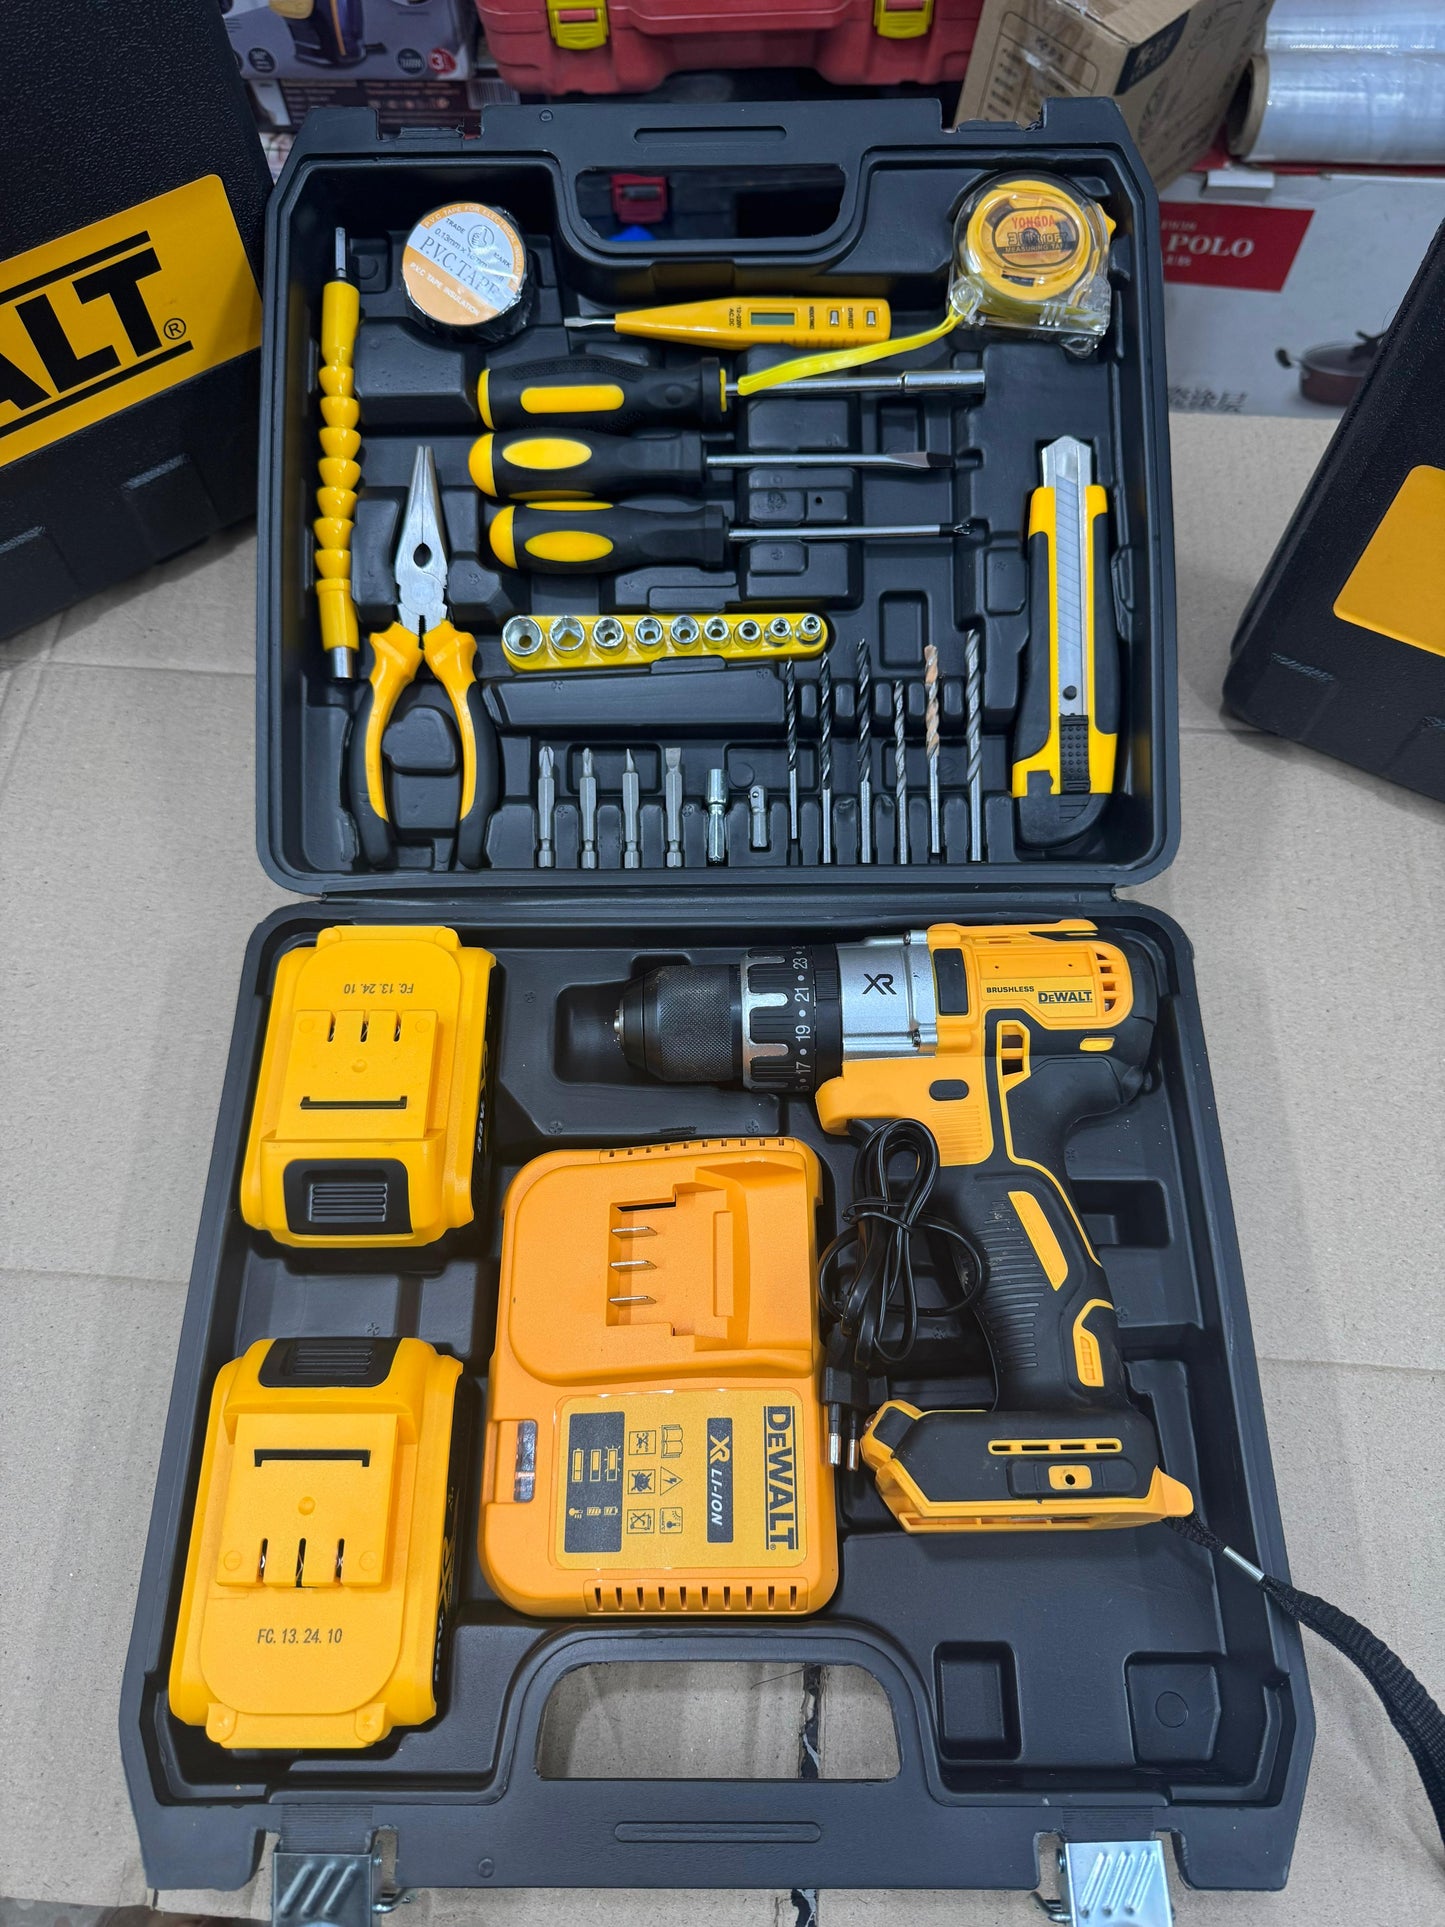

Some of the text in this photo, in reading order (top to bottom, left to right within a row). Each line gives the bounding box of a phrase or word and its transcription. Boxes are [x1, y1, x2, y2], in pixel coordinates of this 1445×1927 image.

[445, 217, 466, 234] TRADE
[1011, 215, 1055, 230] YONGDA
[1165, 233, 1255, 258] POLO
[792, 957, 808, 970] 23
[862, 973, 898, 995] XR
[986, 985, 1034, 994] BRUSHLESS
[794, 986, 810, 1003] 21
[795, 1024, 811, 1042] 19
[795, 1061, 811, 1074] 17
[709, 1435, 730, 1526] XR LI-ION
[328, 1628, 343, 1644] 10
